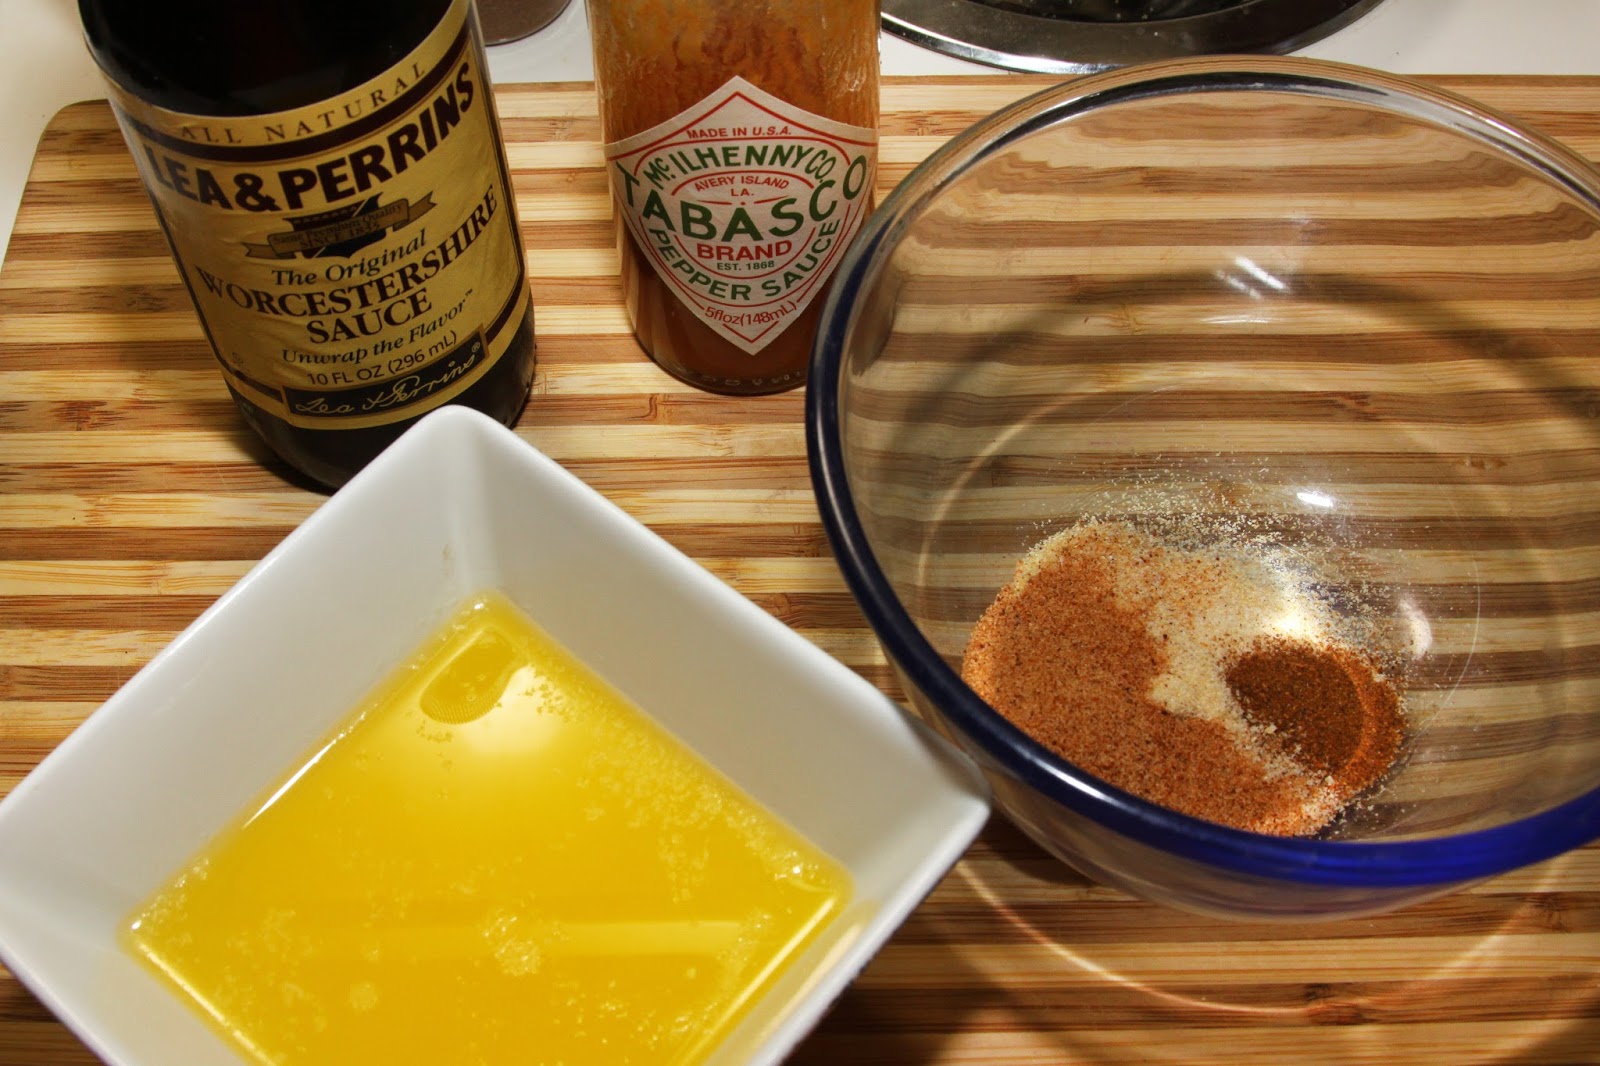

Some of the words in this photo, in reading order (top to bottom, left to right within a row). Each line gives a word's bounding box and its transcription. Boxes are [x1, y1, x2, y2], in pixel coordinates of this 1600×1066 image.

[180, 124, 243, 145] ALL
[263, 61, 427, 143] NATURAL
[686, 127, 728, 139] MADE
[732, 127, 747, 137] IN
[752, 126, 792, 137] U.S.A.
[616, 155, 868, 242] TABASCO
[694, 175, 736, 192] AVERY
[741, 175, 790, 189] ISLAND
[730, 188, 755, 197] LA.
[194, 184, 499, 318] WORCESTERSHIRE
[272, 269, 317, 287] The
[325, 228, 427, 283] Original
[648, 228, 752, 301] PEPPER
[761, 219, 841, 298] SAUCE
[696, 239, 794, 261] BRAND
[717, 261, 742, 271] EST.
[747, 259, 775, 271] 1868
[306, 287, 433, 344] SAUCE
[282, 347, 368, 365] Unwrap
[373, 338, 404, 355] the
[307, 372, 328, 386] 10
[332, 371, 354, 385] FL
[356, 365, 385, 381] OZ
[387, 349, 426, 376] (296
[428, 332, 458, 357] mL)
